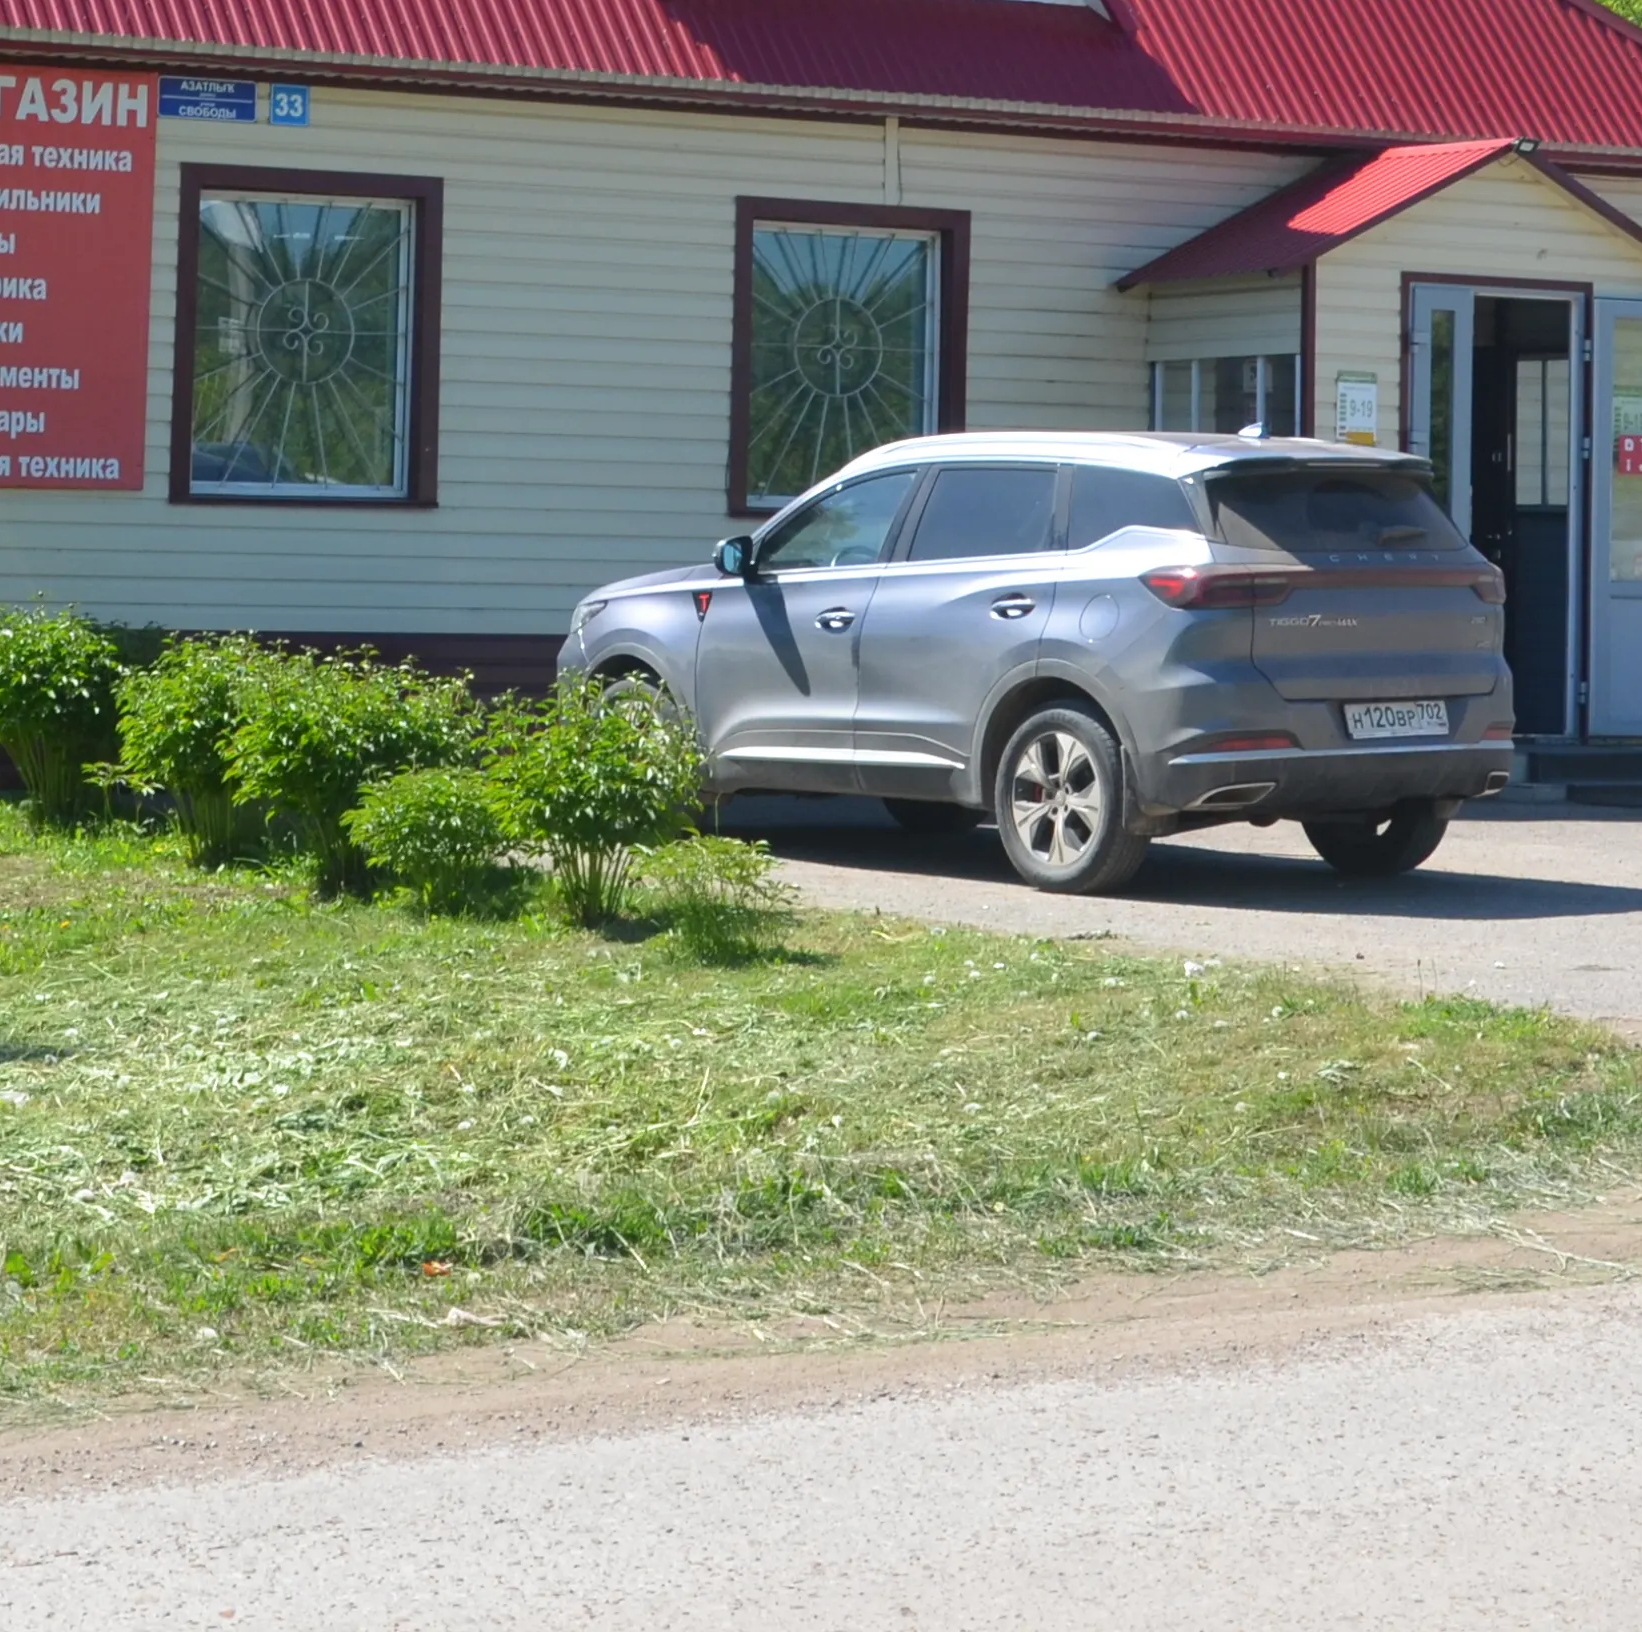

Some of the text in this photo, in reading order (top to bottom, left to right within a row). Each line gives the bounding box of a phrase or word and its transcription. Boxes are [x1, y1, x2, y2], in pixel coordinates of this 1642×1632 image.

[178, 106, 236, 118] СВОБОДЫ
[275, 93, 303, 117] 33
[31, 145, 132, 172] техника
[18, 455, 119, 480] техника
[1417, 703, 1443, 719] 702
